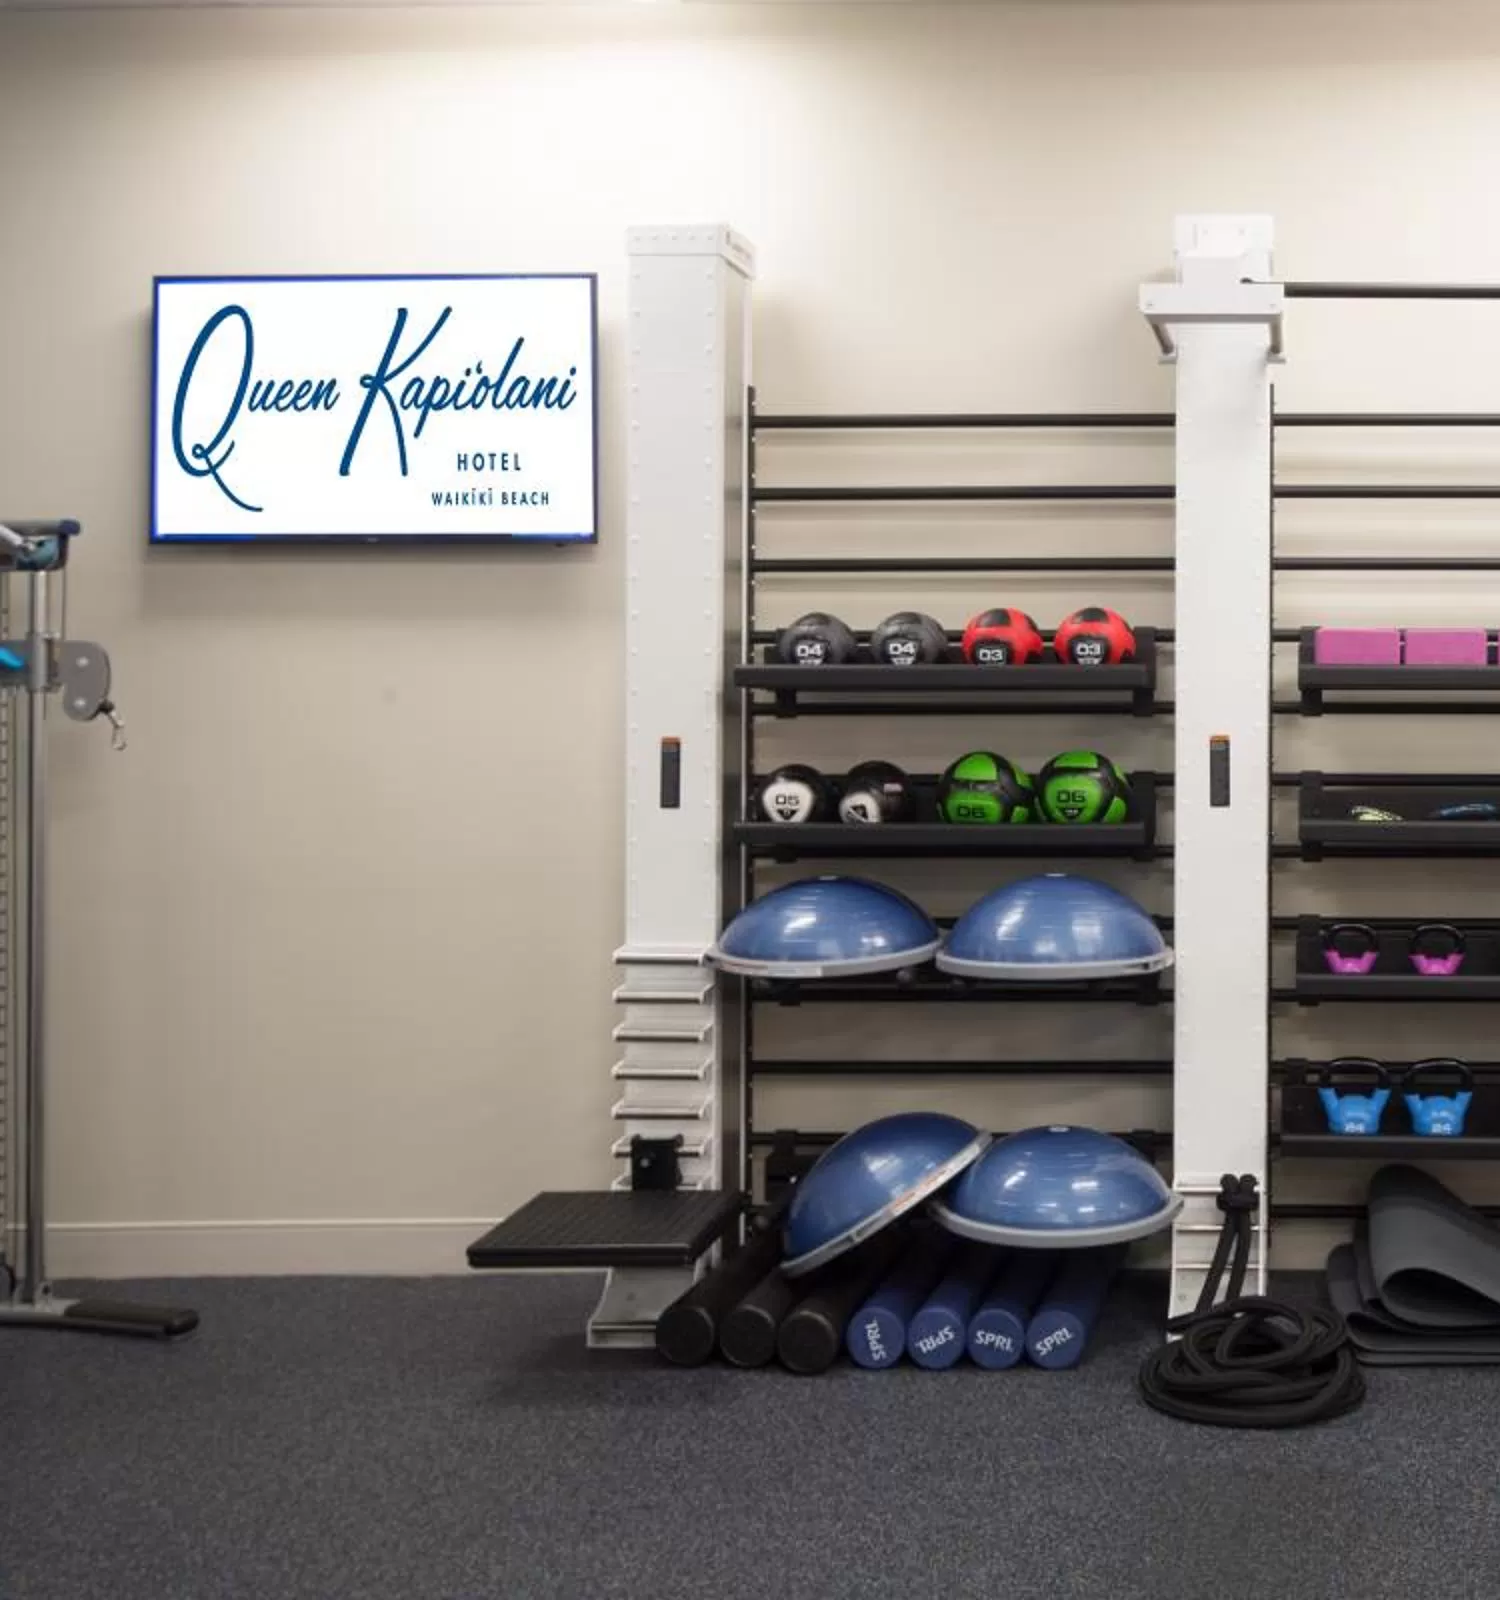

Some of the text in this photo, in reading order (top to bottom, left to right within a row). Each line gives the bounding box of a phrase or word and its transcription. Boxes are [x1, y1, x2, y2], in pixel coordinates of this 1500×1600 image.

[171, 304, 341, 513] Queen
[457, 452, 521, 472] HOTEL
[501, 491, 549, 506] BEACH
[796, 643, 822, 657] 04
[889, 642, 915, 655] 04
[979, 648, 1003, 661] 03
[1076, 643, 1100, 655] 03
